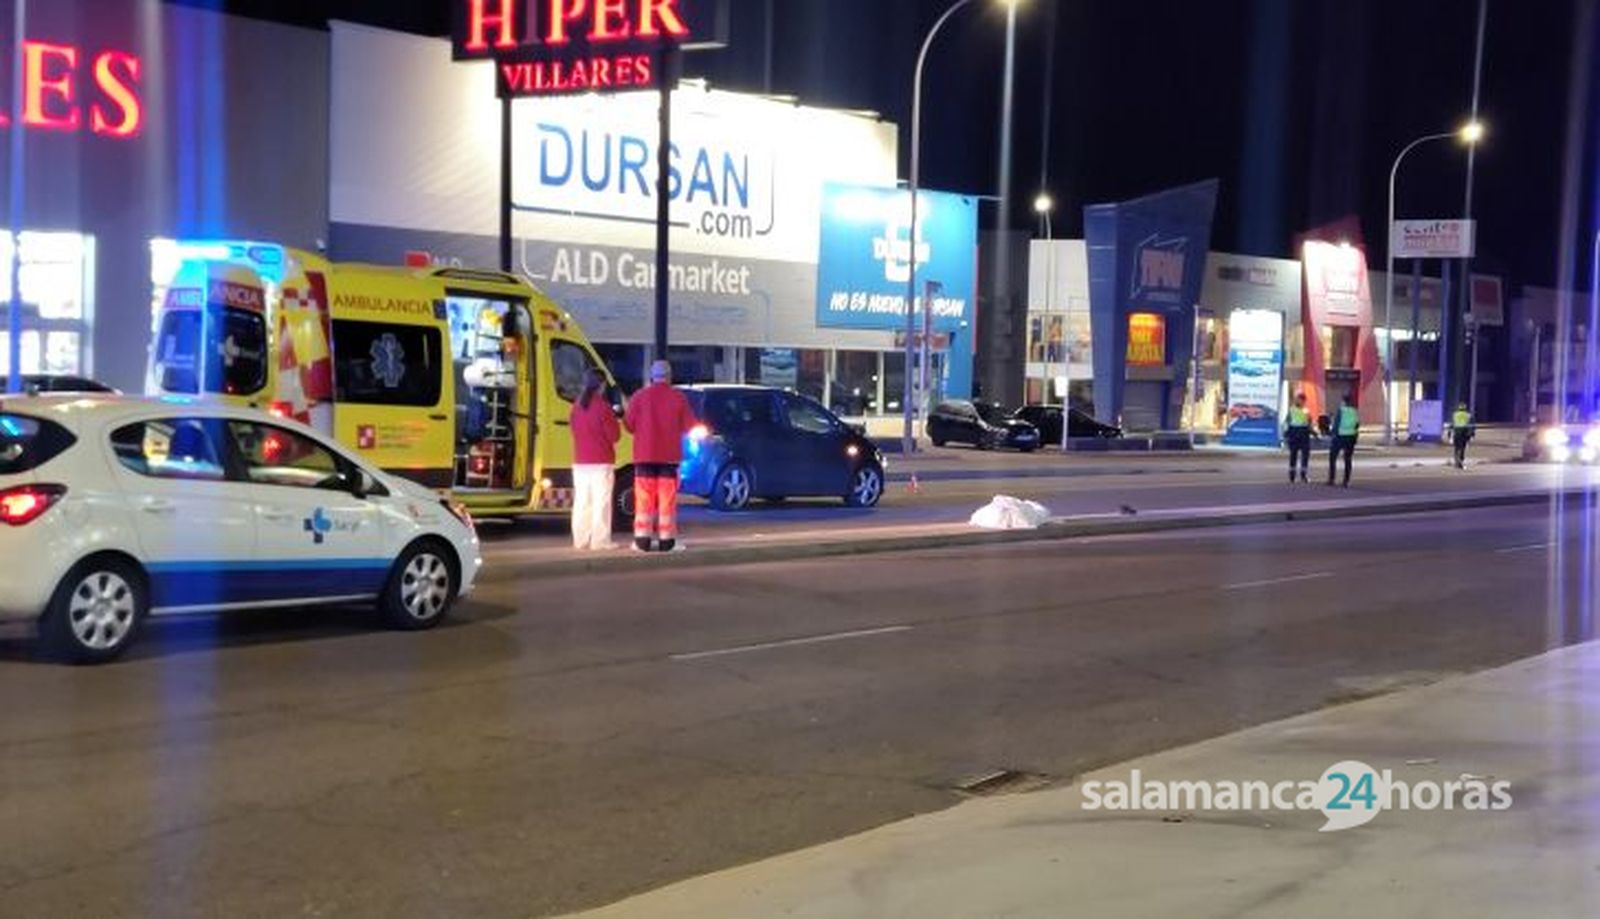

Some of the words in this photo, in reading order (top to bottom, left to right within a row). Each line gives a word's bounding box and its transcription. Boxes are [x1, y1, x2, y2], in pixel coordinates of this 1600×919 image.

[464, 0, 689, 49] HIPER
[0, 40, 142, 137] ES
[503, 55, 651, 91] VILLARES
[537, 122, 749, 209] DURSAN
[695, 209, 752, 238] .com
[551, 248, 609, 285] ALD
[333, 292, 431, 316] AMBULANCIA
[830, 292, 848, 312] NO
